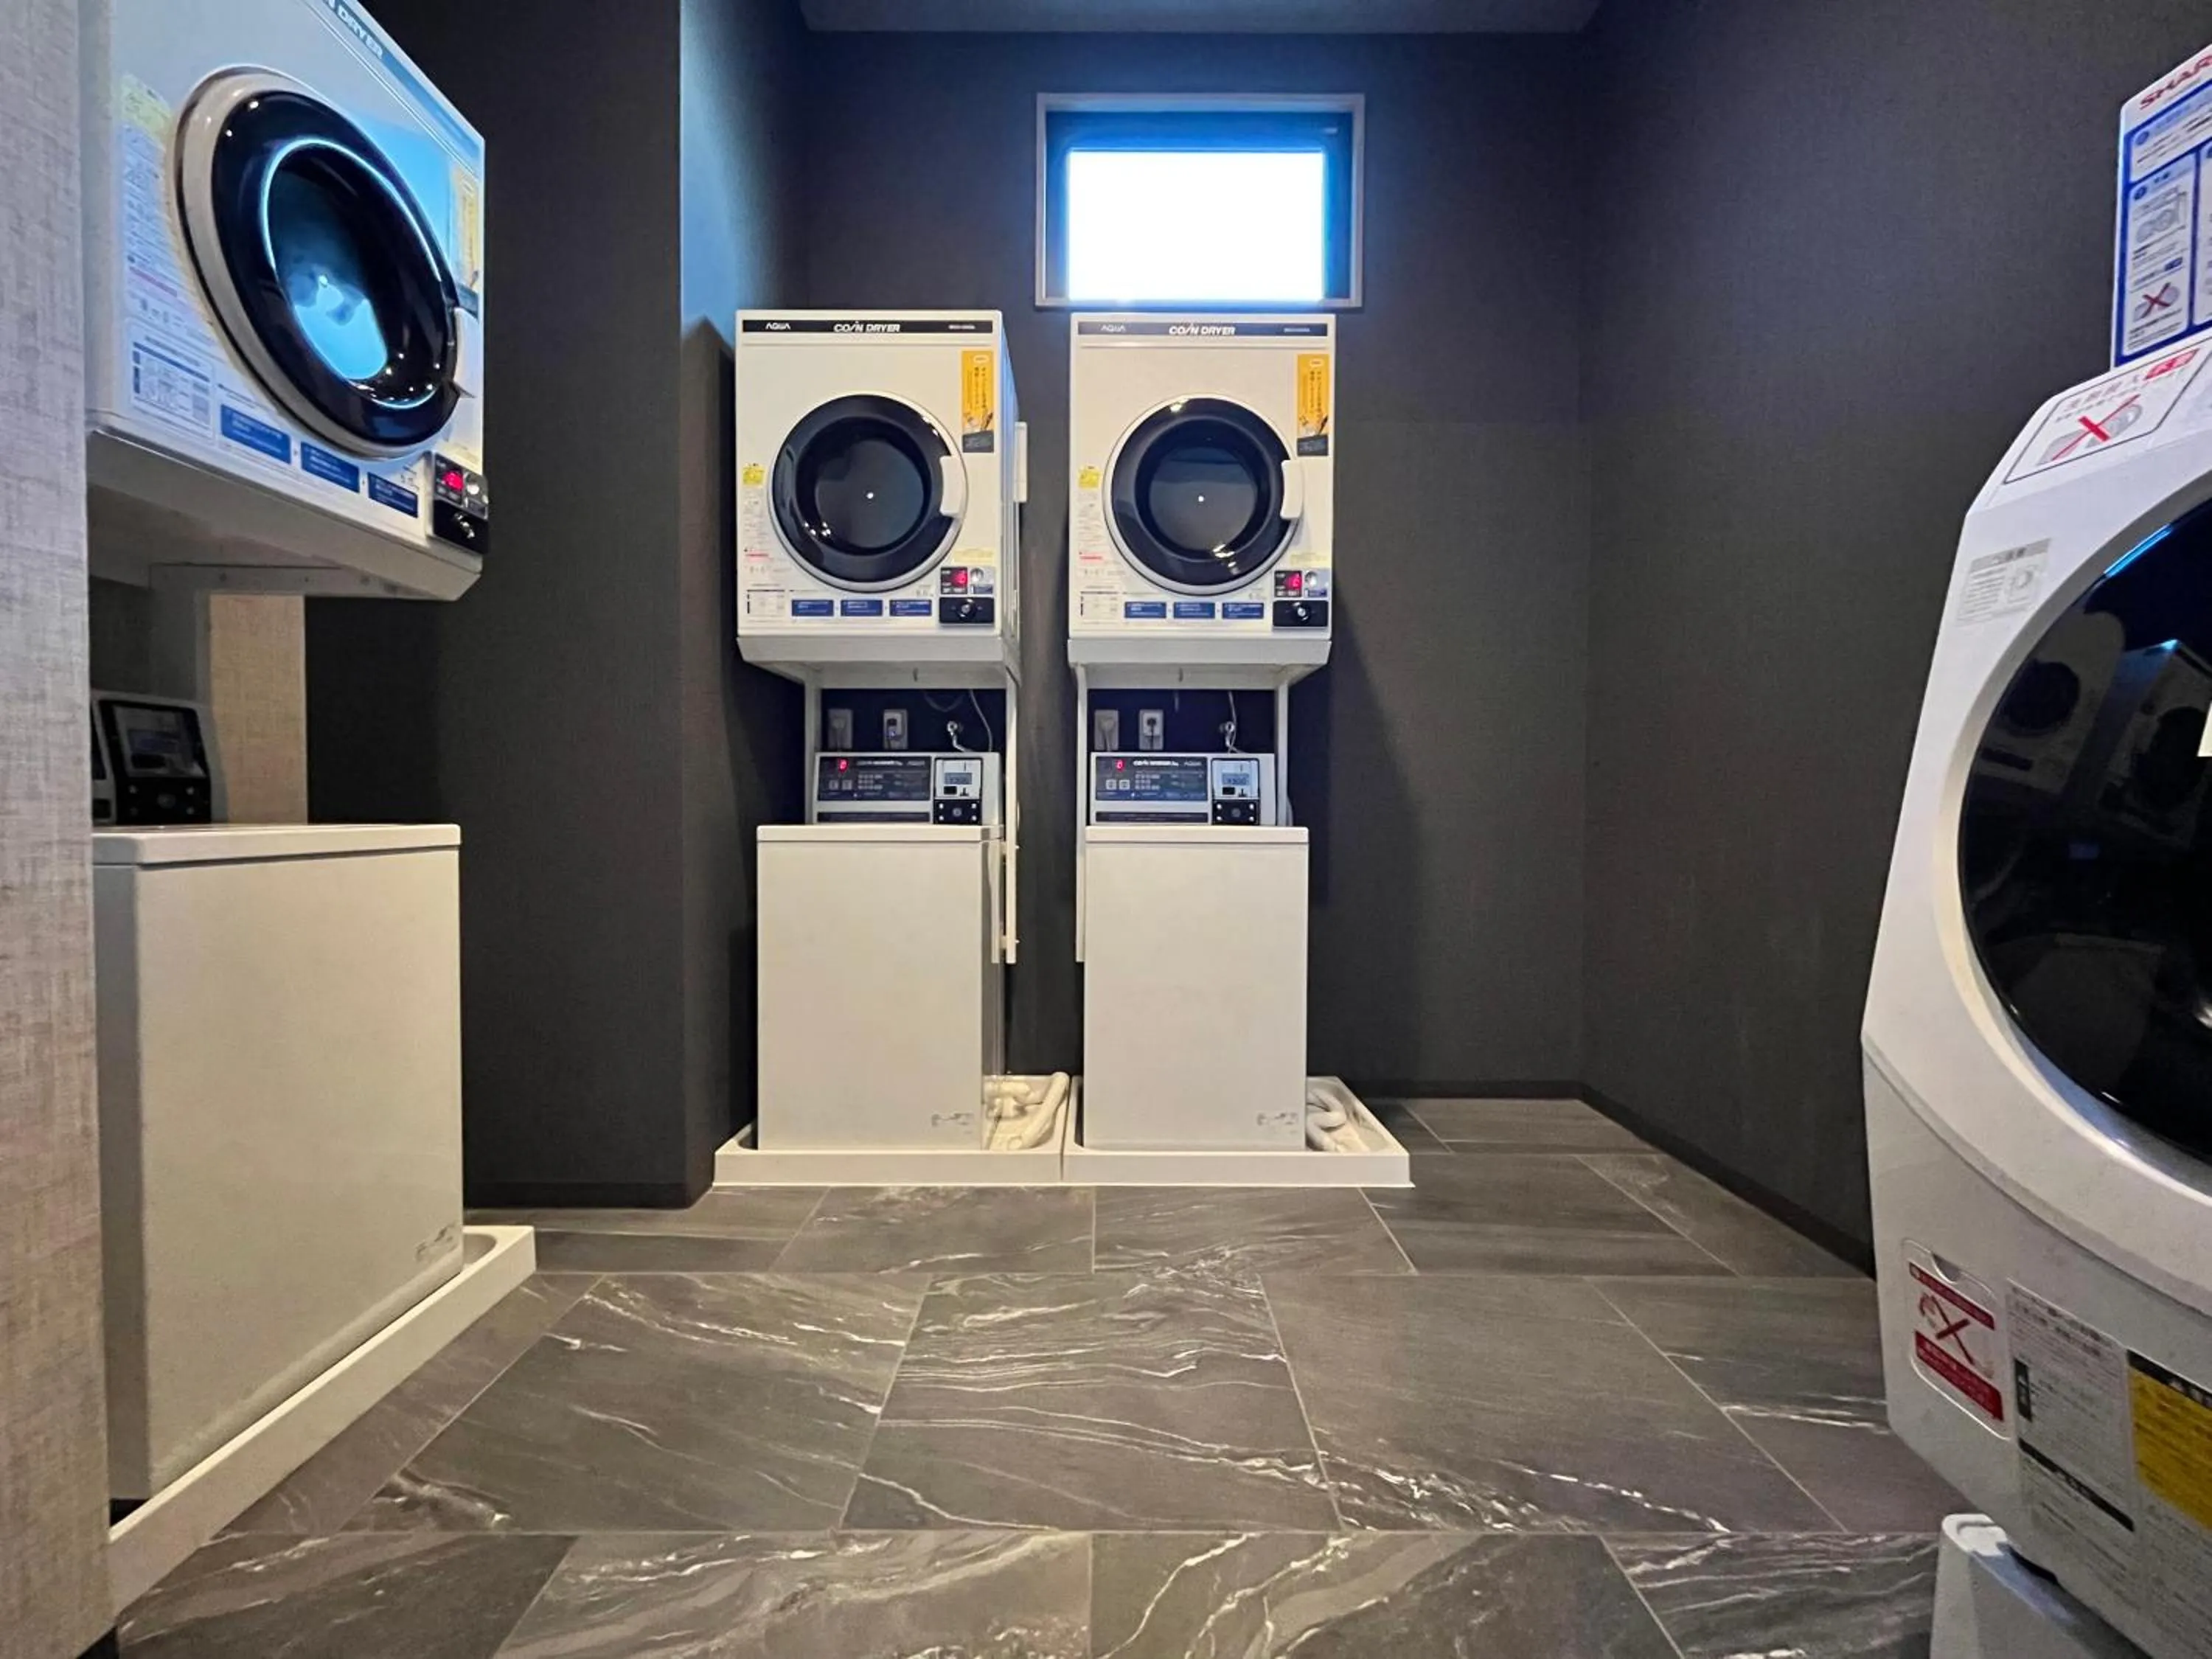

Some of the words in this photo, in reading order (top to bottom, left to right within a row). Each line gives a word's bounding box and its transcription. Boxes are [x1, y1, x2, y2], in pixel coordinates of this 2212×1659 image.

[338, 4, 383, 59] DRYER
[866, 323, 900, 333] DRYER
[1100, 324, 1126, 332] AQUA
[1169, 322, 1199, 335] COIN
[1201, 325, 1236, 335] DRYER
